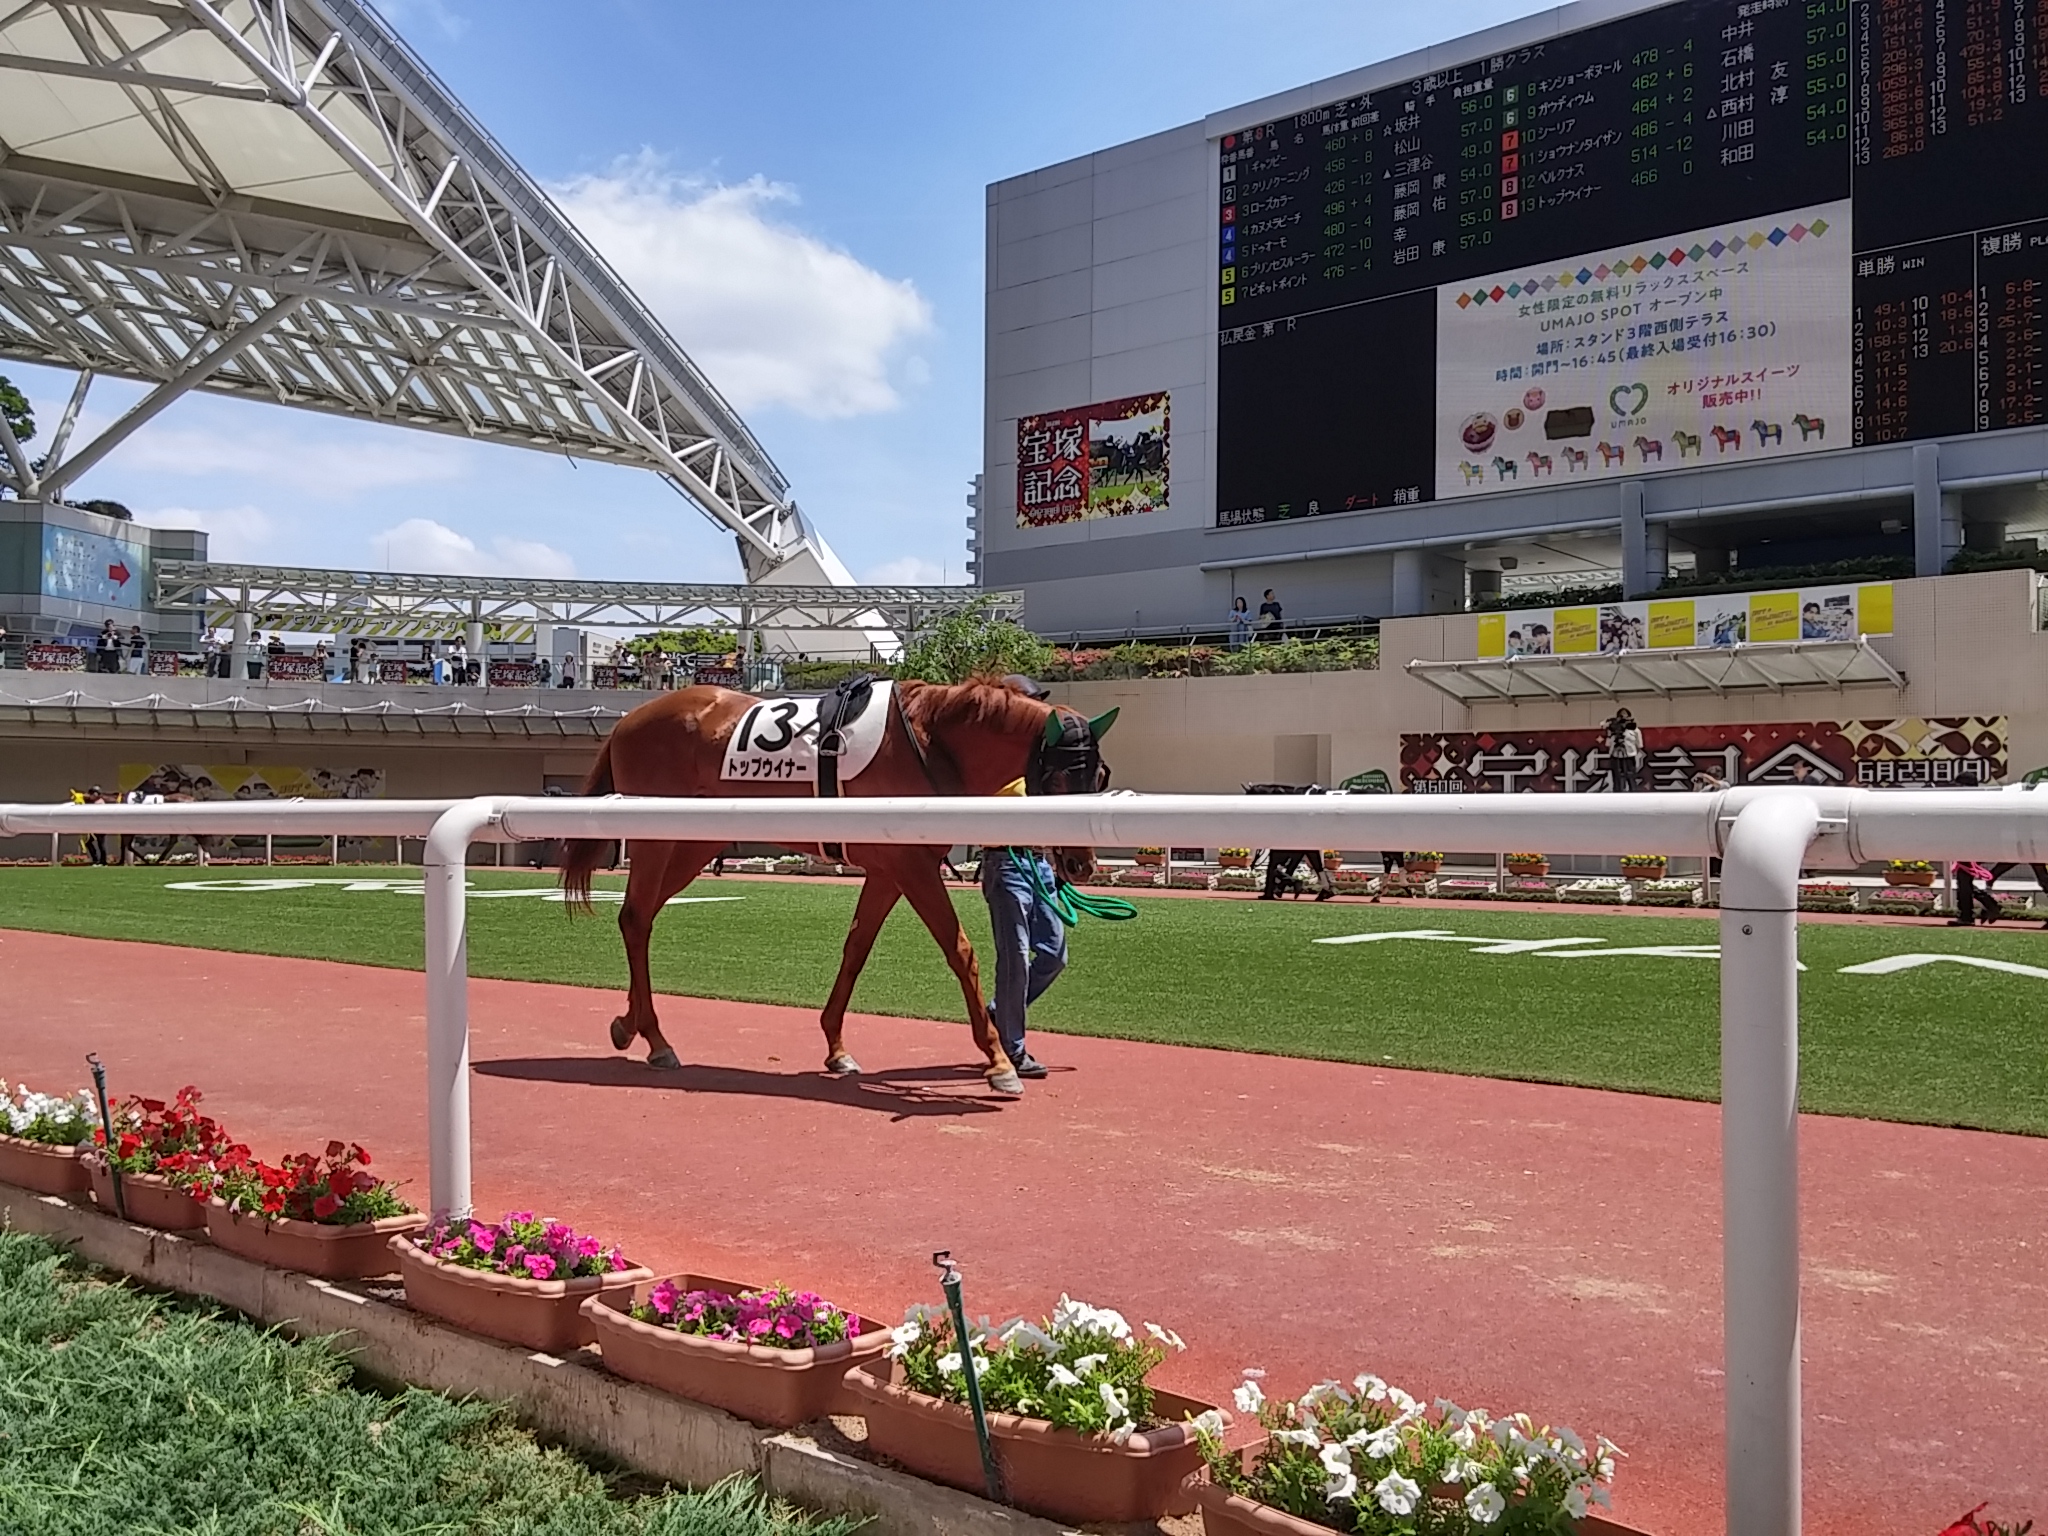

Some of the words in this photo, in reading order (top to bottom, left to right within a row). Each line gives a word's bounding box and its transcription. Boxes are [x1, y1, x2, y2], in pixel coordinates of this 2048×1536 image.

[1632, 49, 1658, 67] 478
[1721, 19, 1755, 42] 中井
[1632, 72, 1658, 91] 462
[1720, 43, 1755, 68] 石橋
[1806, 22, 1846, 45] 57.0
[1537, 118, 1576, 140] シーリア
[1631, 96, 1658, 115] 464
[1720, 68, 1754, 94] 北村
[1770, 61, 1789, 81] 友
[1806, 47, 1847, 70] 55.0
[1631, 120, 1658, 139] 486
[1720, 93, 1754, 118] 西村
[1770, 85, 1789, 106] 淳
[1806, 72, 1847, 95] 55.0
[1294, 108, 1330, 129] 1800m
[1325, 137, 1346, 152] 460
[1394, 113, 1421, 133] 坂井
[1461, 95, 1493, 115] 56.0
[1631, 144, 1658, 163] 514
[1721, 118, 1754, 143] 川田
[1806, 98, 1847, 121] 54.0
[1324, 180, 1345, 194] 426
[1394, 153, 1434, 178] 三津谷
[1461, 140, 1493, 158] 49.0
[1325, 158, 1345, 173] 456
[1394, 136, 1420, 156] 松山
[1461, 118, 1493, 138] 57.0
[1631, 169, 1658, 187] 466
[1720, 143, 1754, 167] 和田
[1806, 124, 1847, 146] 54.0
[1324, 201, 1345, 216] 496
[1460, 163, 1492, 182] 54.0
[1324, 222, 1345, 237] 480
[1460, 185, 1492, 205] 57.0
[1323, 265, 1344, 280] 476
[1393, 245, 1419, 265] 岩田
[1460, 231, 1492, 250] 57.0
[1324, 244, 1345, 258] 472
[1393, 226, 1407, 243] 幸
[1460, 208, 1492, 227] 55.0
[1981, 232, 2022, 256] 複勝
[1857, 255, 1895, 278] 単勝
[1902, 257, 1925, 270] WIN
[1287, 317, 1297, 332] R
[1541, 312, 1594, 332] UMAJO
[1601, 302, 1642, 321] SPOT
[1649, 286, 1723, 311] オープン中
[1912, 296, 1928, 311] 10
[1912, 312, 1926, 327] 11
[1912, 328, 1928, 343] 12
[1912, 343, 1928, 359] 13
[1667, 364, 1800, 395] オリジナルスイーツ
[1023, 425, 1083, 467] 宝塚
[1023, 465, 1083, 505] 記念
[737, 702, 798, 752] 13
[729, 757, 807, 778] トップウイナー
[1413, 779, 1463, 793] 第60回
